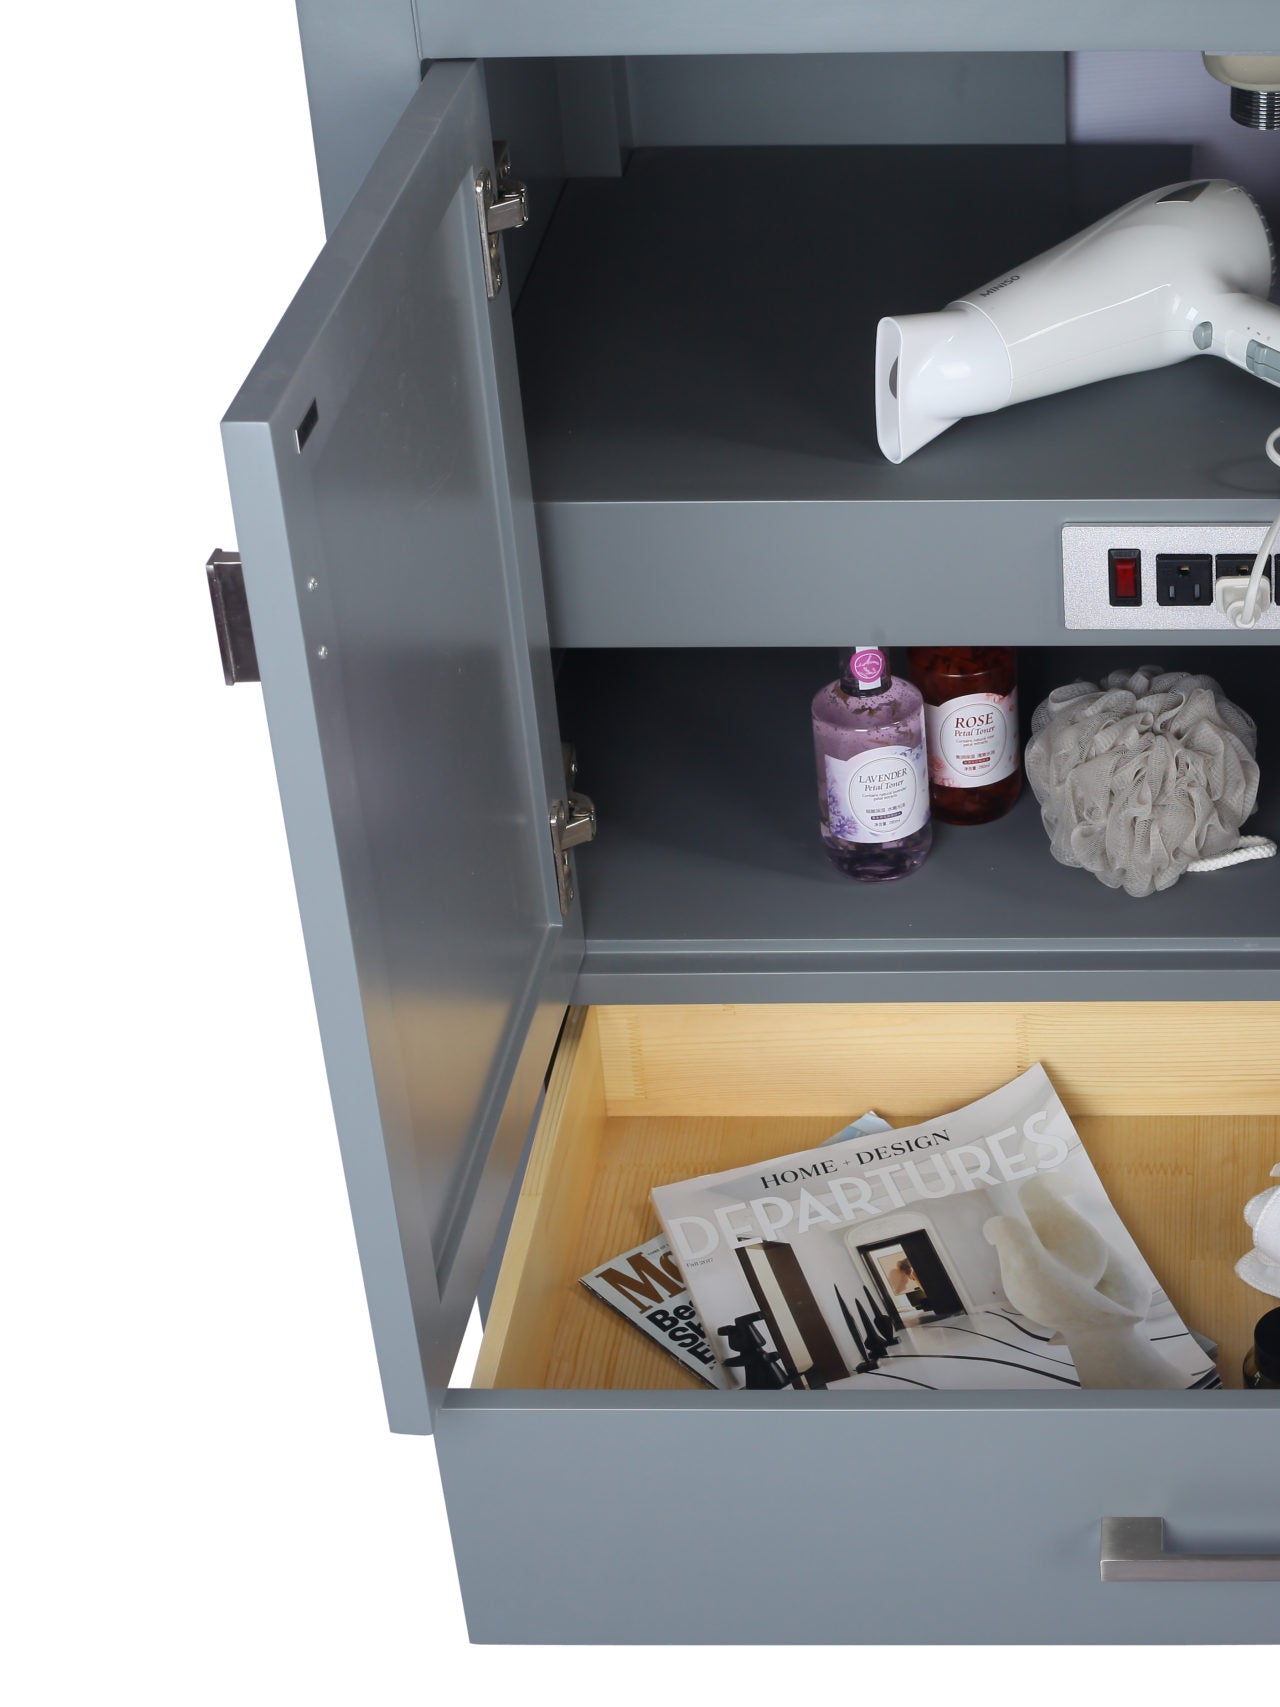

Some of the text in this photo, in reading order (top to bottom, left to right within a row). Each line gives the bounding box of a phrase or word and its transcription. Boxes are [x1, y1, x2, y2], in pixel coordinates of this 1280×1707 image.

[955, 712, 994, 729] ROSE
[954, 725, 996, 737] Petal Toner
[859, 768, 908, 783] LAVENDER
[864, 780, 905, 791] Petal Toner
[760, 1159, 838, 1189] HOME
[855, 1129, 951, 1166] DESIGN
[667, 1110, 1070, 1261] DEPARTURES
[646, 1300, 697, 1333] Be
